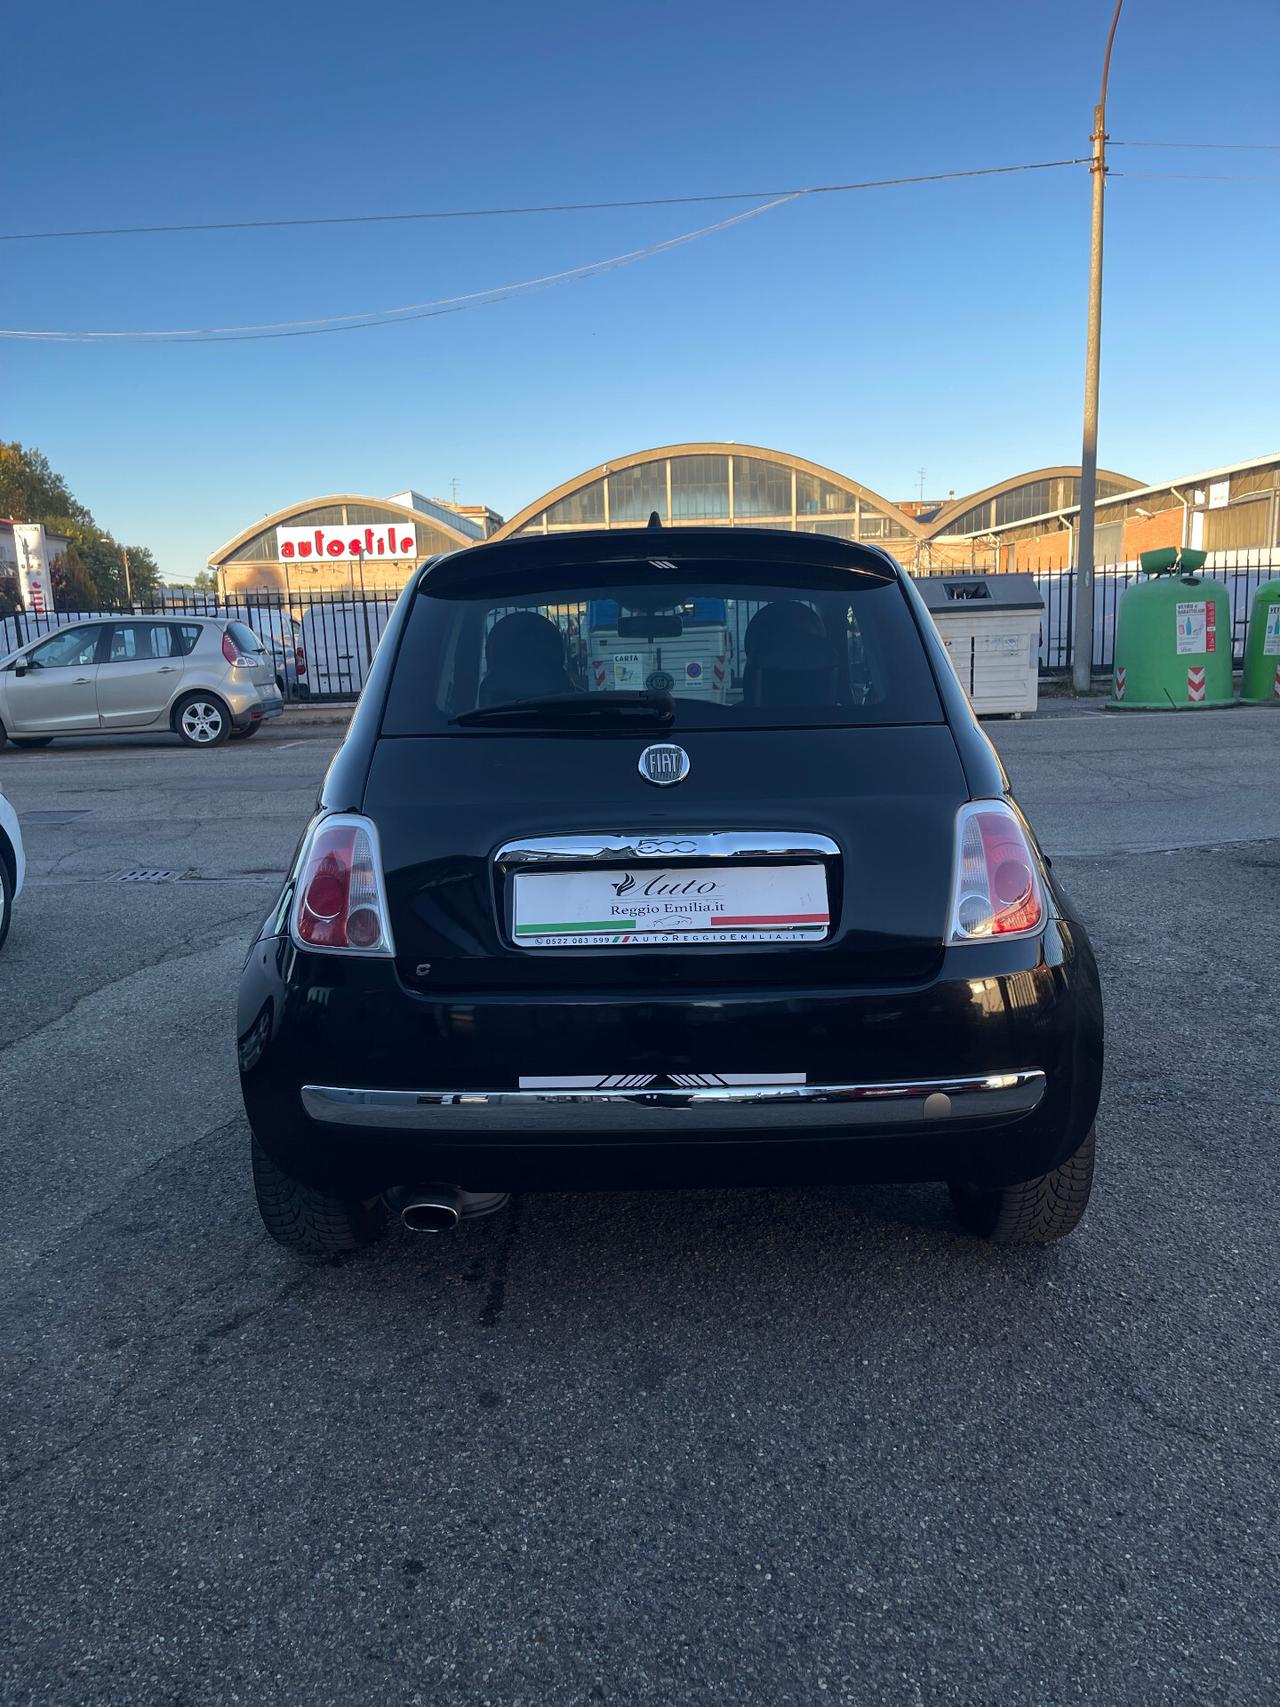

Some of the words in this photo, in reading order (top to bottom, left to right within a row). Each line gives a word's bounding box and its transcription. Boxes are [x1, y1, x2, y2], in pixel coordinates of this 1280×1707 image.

[281, 527, 414, 557] autostile
[649, 753, 678, 773] FIAT
[638, 838, 698, 854] 500
[621, 873, 717, 896] Auto
[611, 904, 660, 917] Reggio
[664, 901, 725, 913] Emilia.it
[545, 937, 568, 945] 0522
[593, 936, 610, 944] 599
